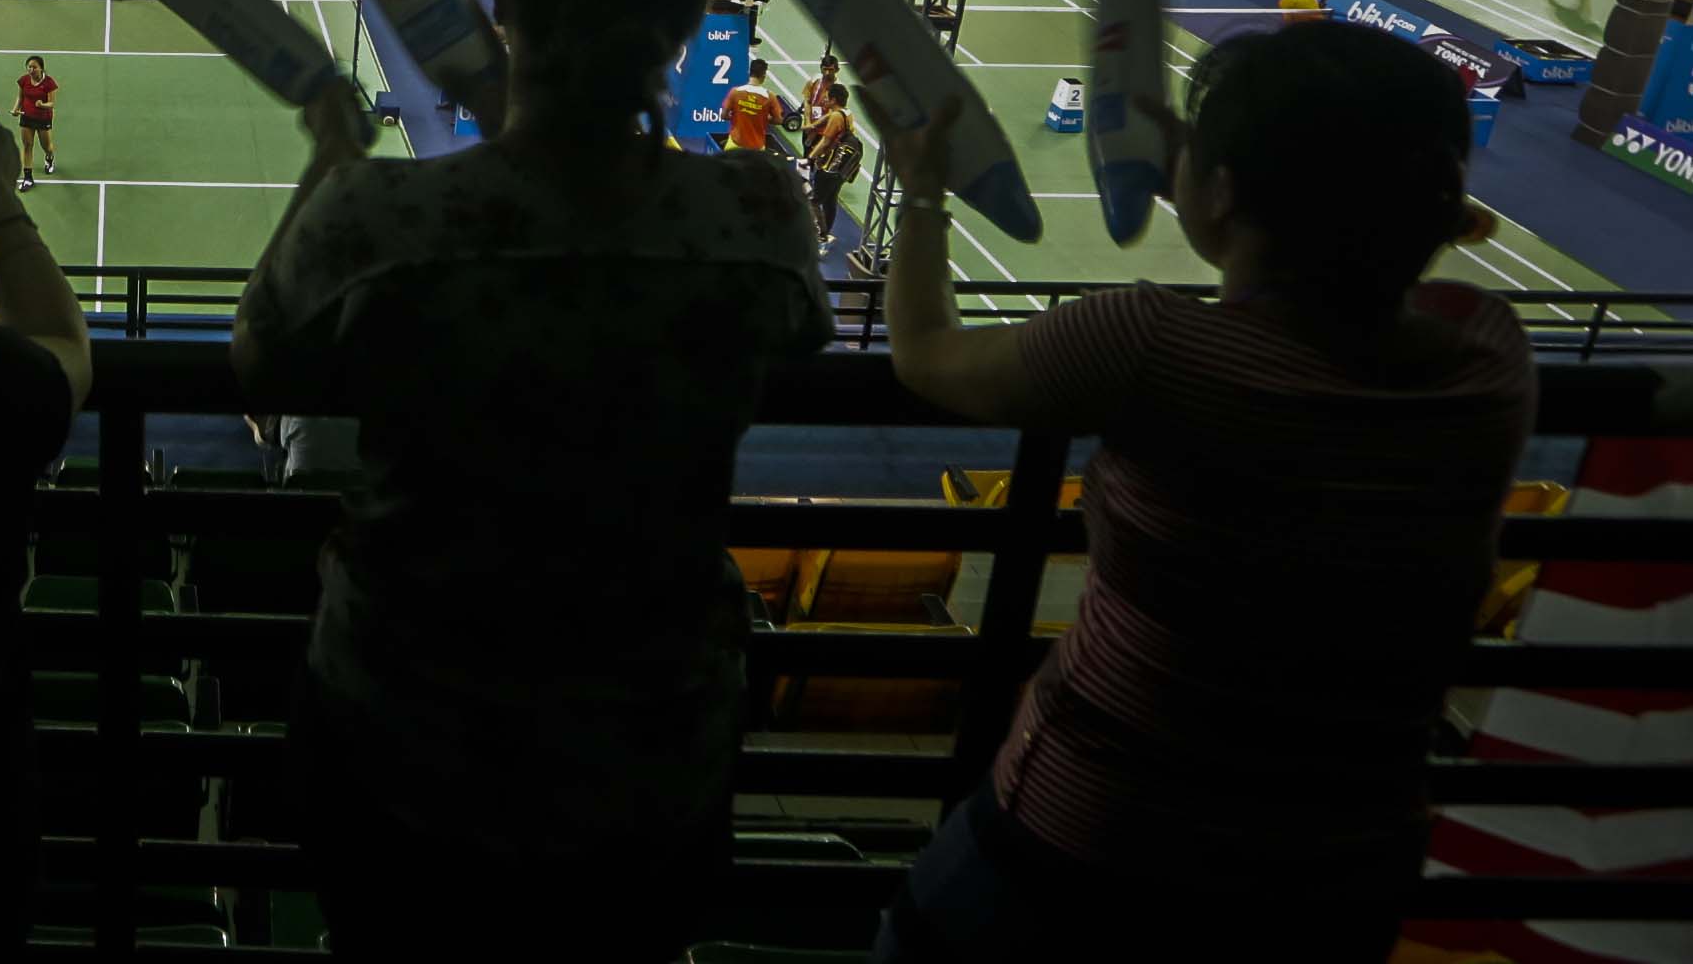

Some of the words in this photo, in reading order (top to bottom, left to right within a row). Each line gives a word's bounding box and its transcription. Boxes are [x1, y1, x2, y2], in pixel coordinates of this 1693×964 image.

[712, 54, 732, 85] 2
[1071, 89, 1080, 102] 2
[1654, 142, 1693, 183] YON
